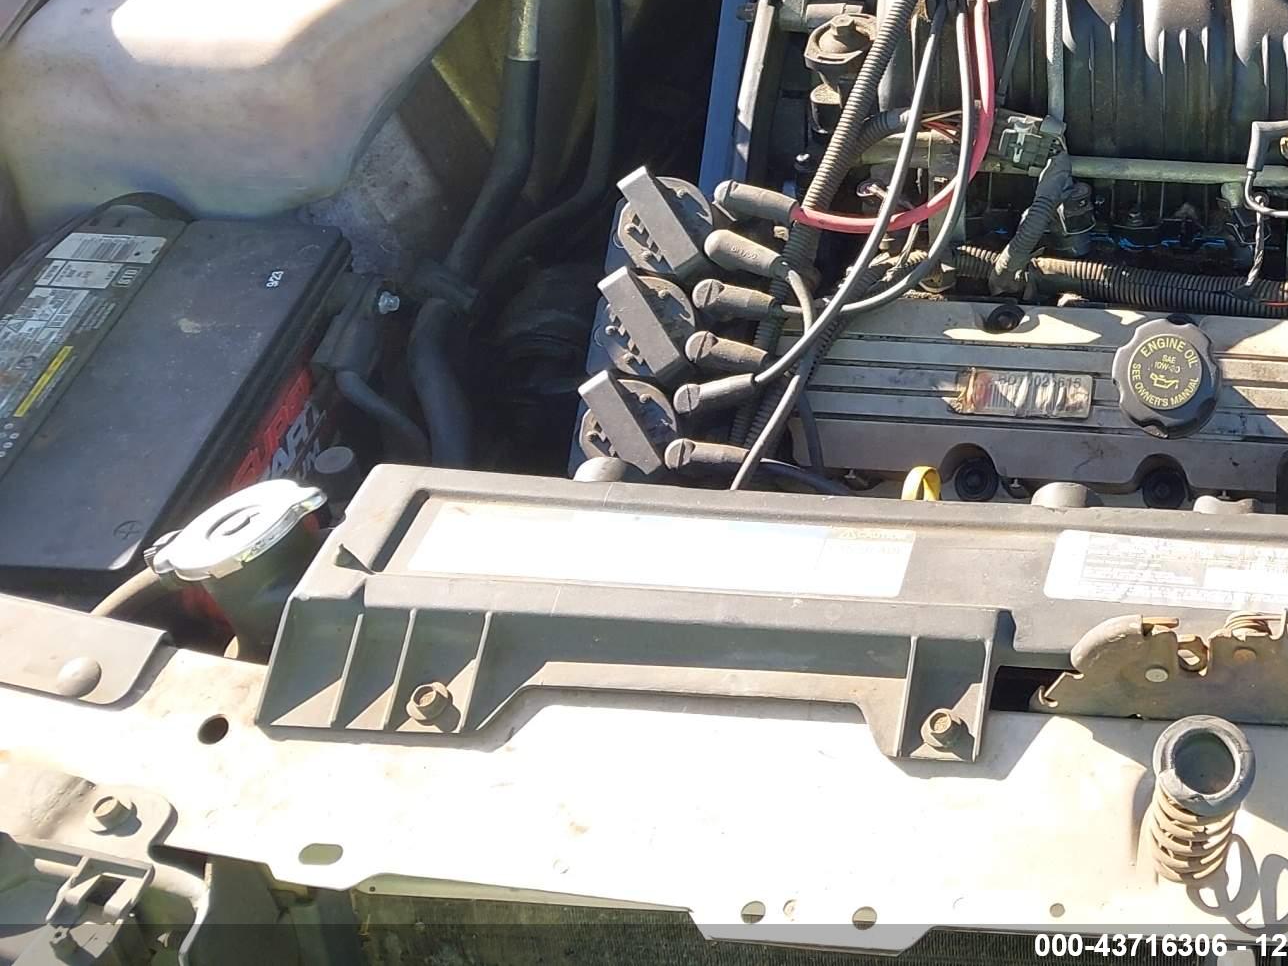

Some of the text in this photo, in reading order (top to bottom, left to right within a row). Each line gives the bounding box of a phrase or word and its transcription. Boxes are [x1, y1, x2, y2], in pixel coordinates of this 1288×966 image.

[1140, 337, 1199, 369] ENGINE OIL
[1161, 354, 1177, 364] SAE
[1131, 363, 1200, 407] SEE OWNER'S MANUAL
